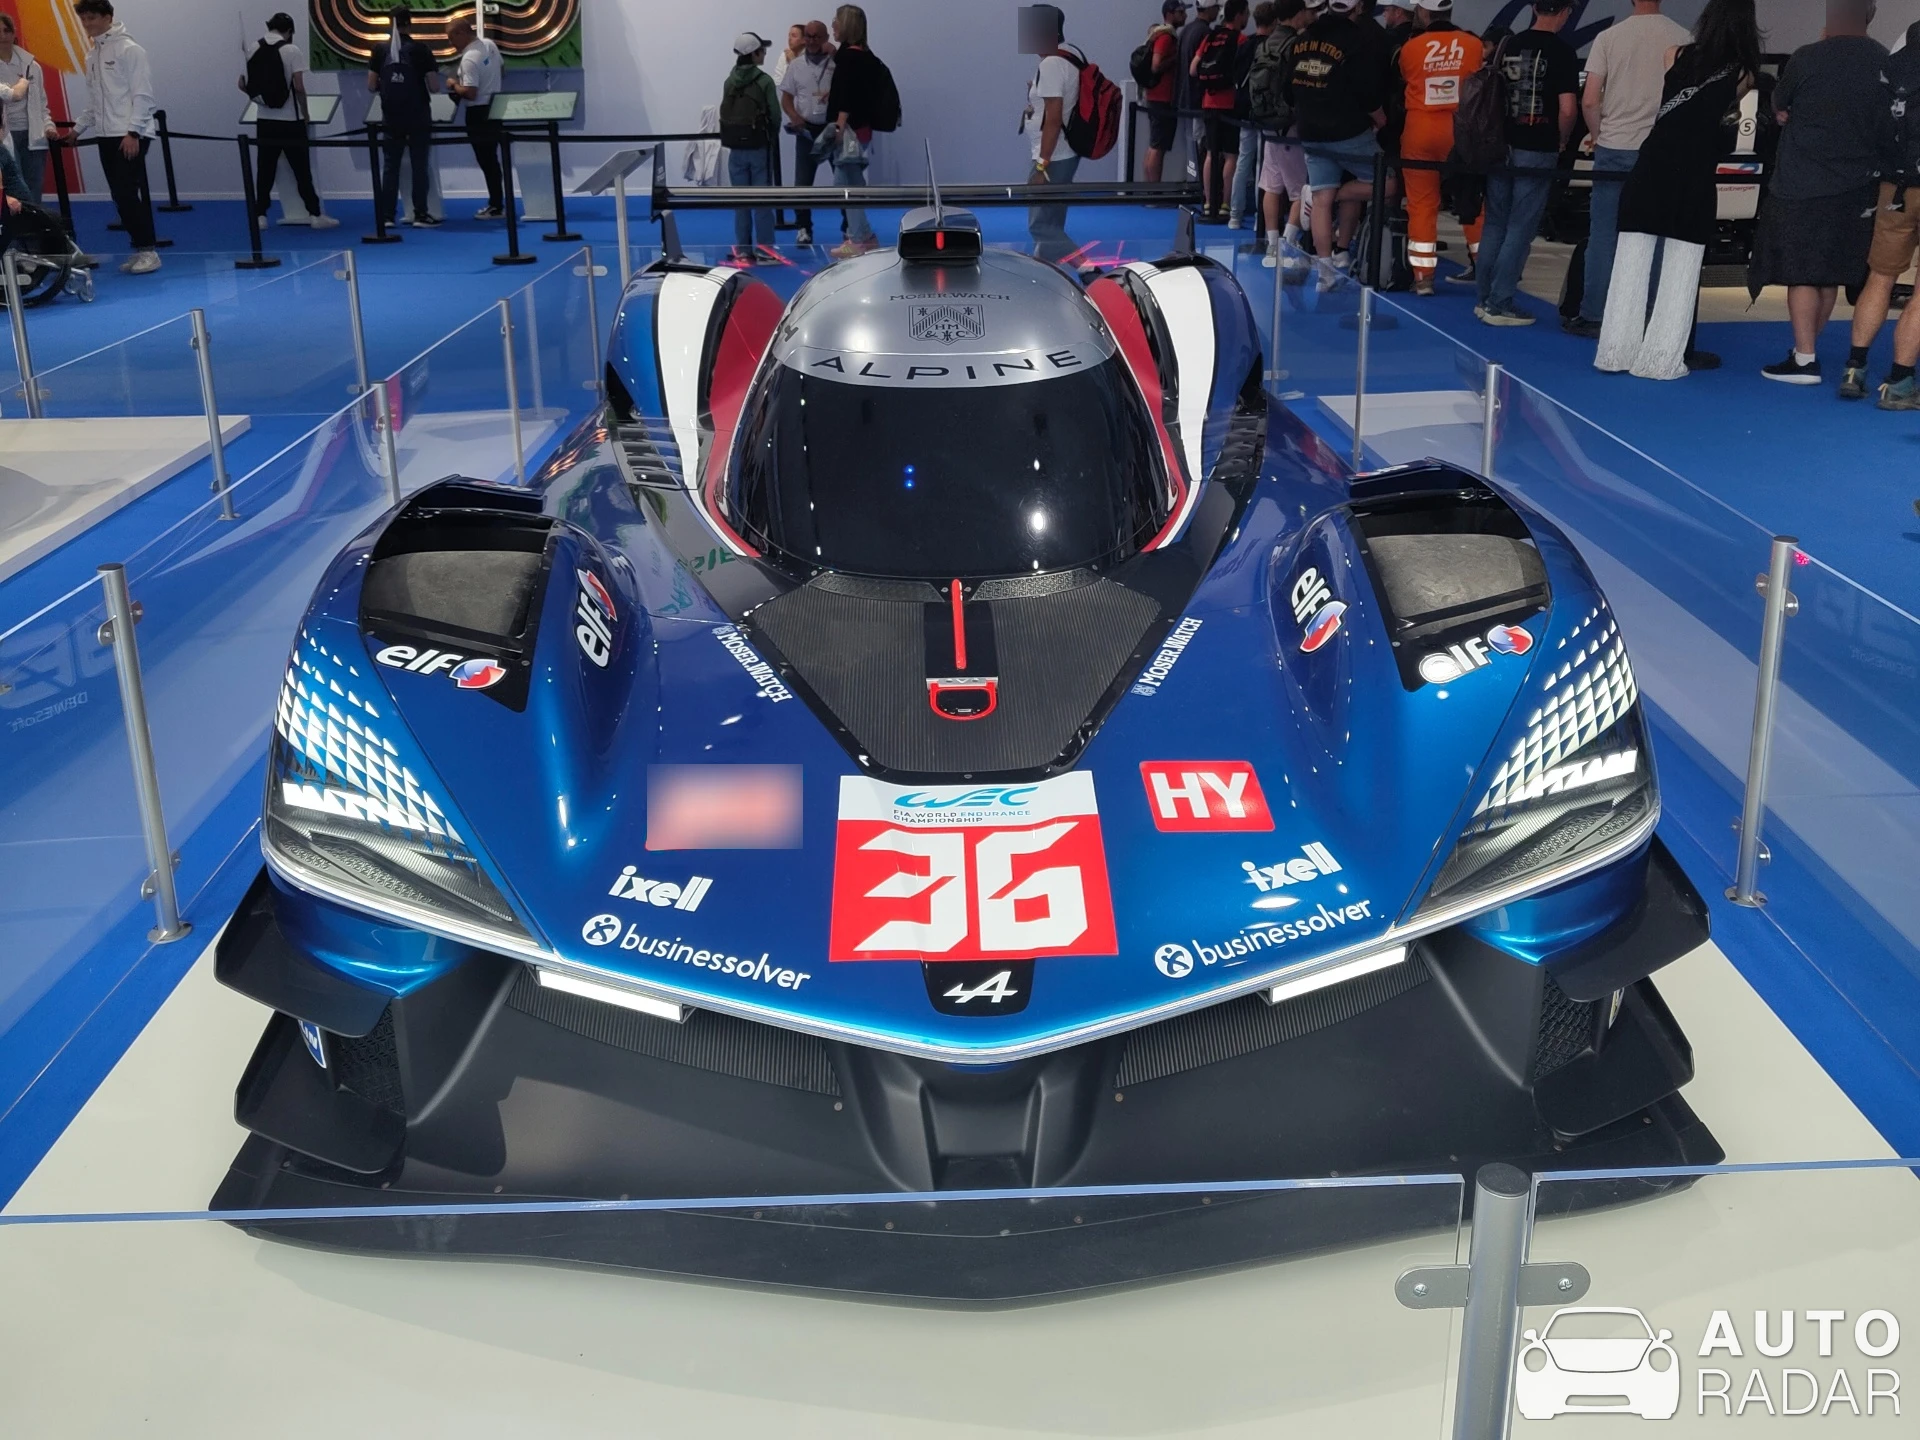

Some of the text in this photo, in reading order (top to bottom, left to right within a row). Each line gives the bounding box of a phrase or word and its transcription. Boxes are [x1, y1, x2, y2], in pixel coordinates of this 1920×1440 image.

[1423, 62, 1435, 71] LE
[1435, 60, 1461, 69] MANS
[1424, 38, 1464, 63] 24h
[1743, 122, 1751, 132] 5
[810, 350, 1082, 380] ALPINE
[1291, 567, 1331, 624] elf
[576, 591, 612, 668] elf
[375, 645, 463, 675] elf
[893, 809, 911, 818] FIA
[894, 786, 1039, 808] WEC
[1150, 773, 1249, 818] HY
[893, 815, 983, 824] CHAMPIONSHIP
[1241, 841, 1343, 892] ixell
[608, 865, 713, 912] ixell
[853, 821, 1088, 953] 36
[1192, 900, 1371, 966] businessolver
[620, 923, 811, 990] businessolver
